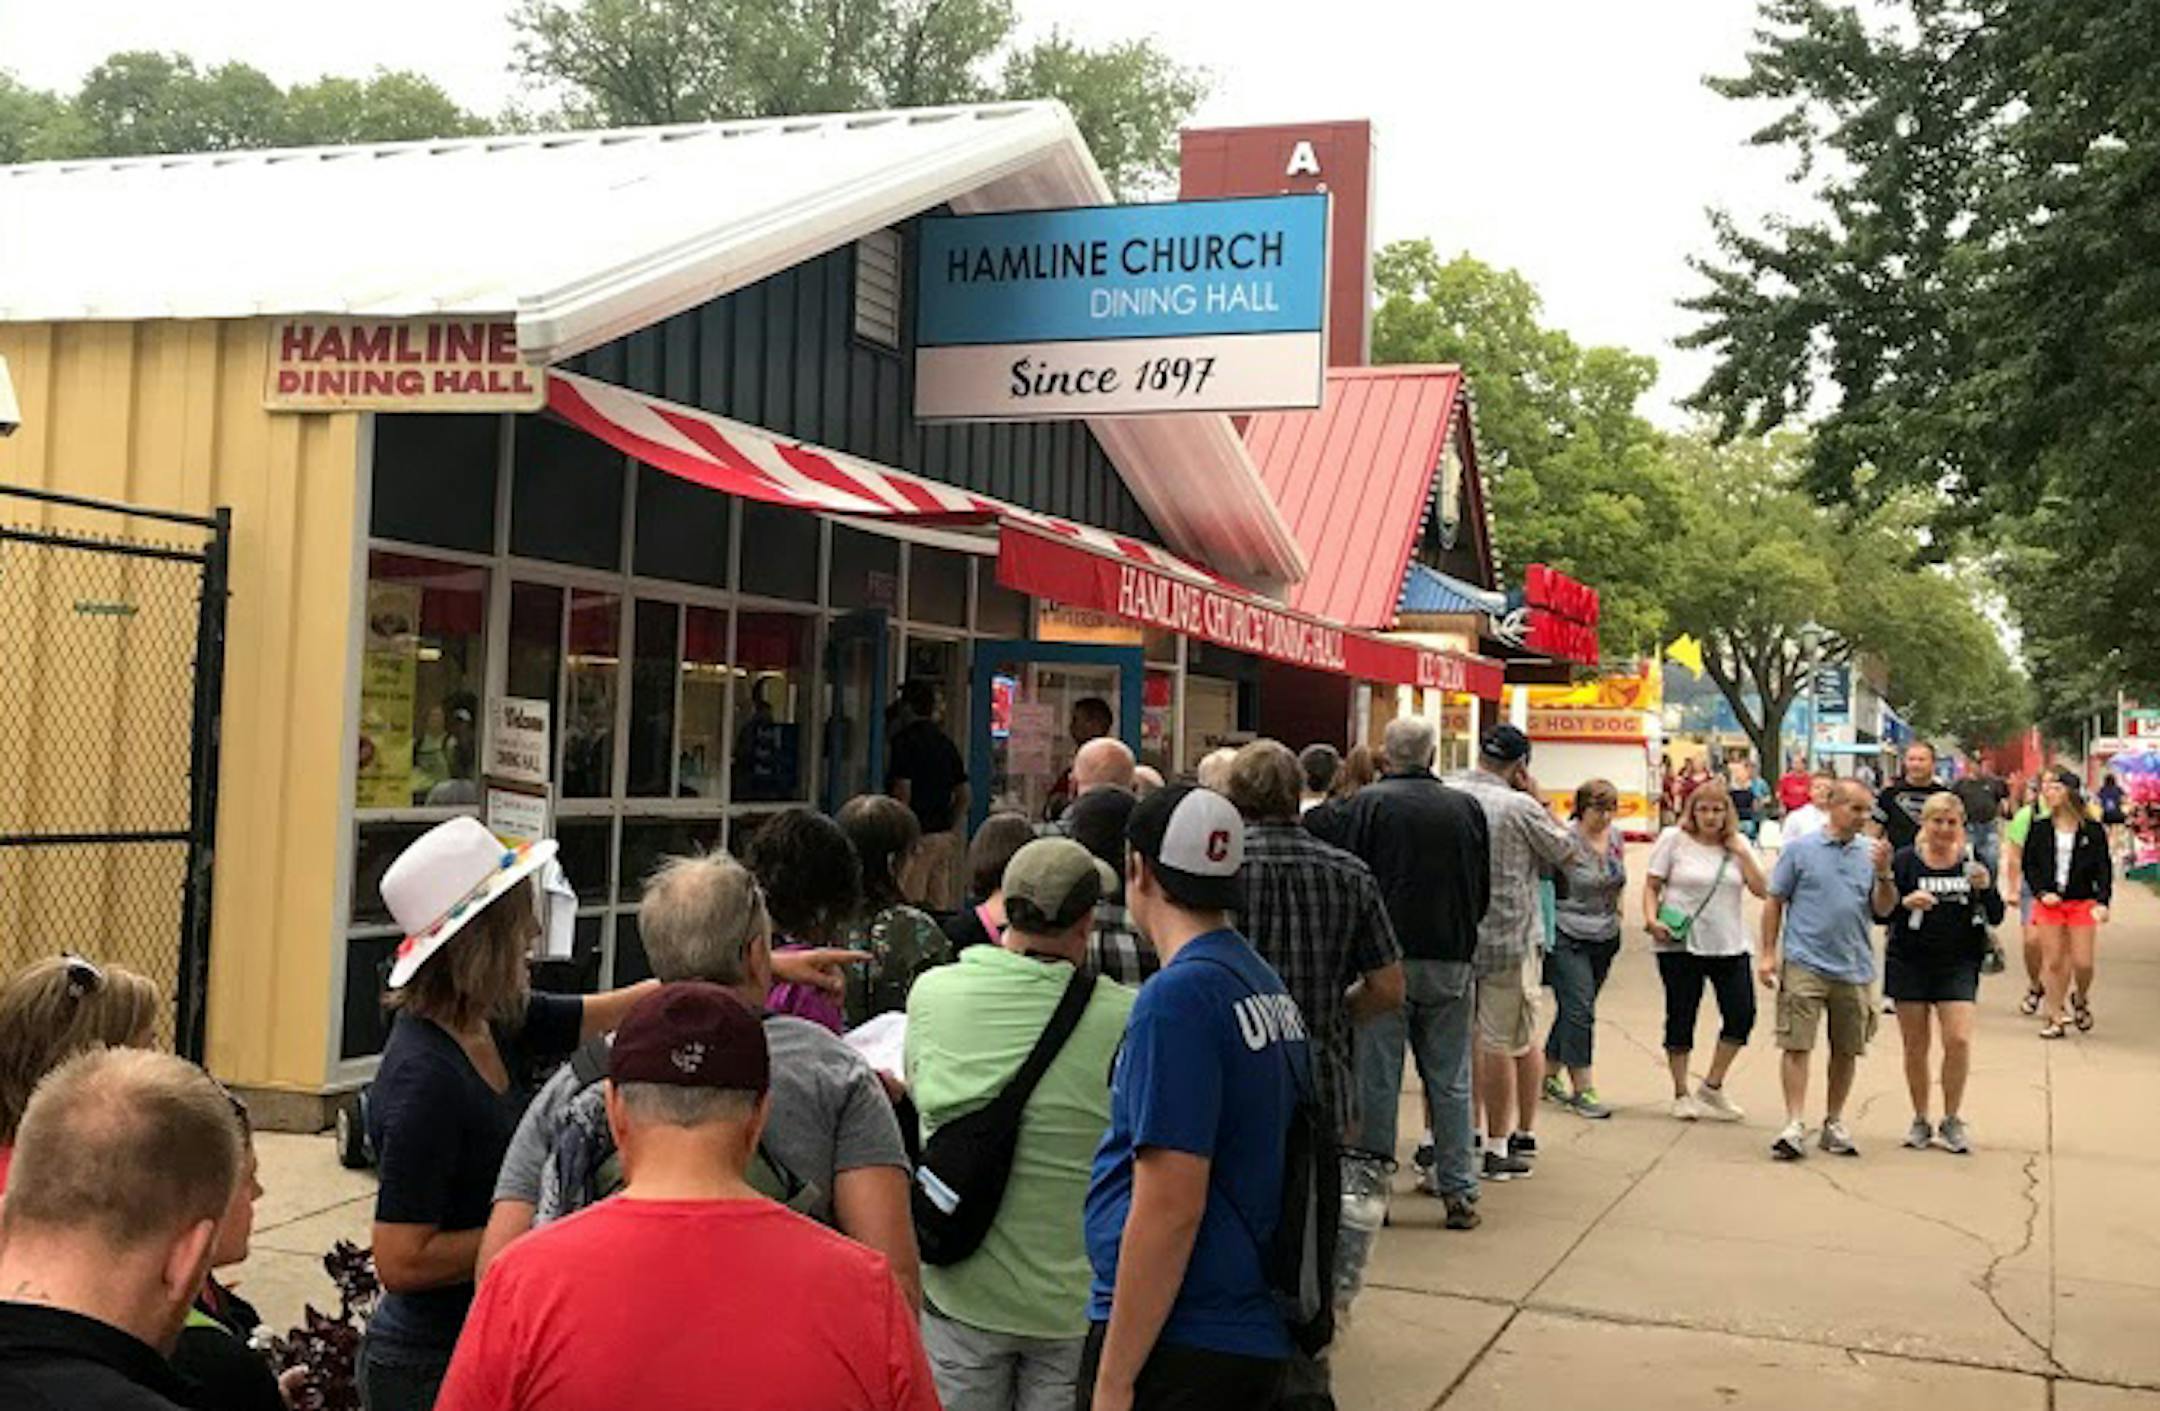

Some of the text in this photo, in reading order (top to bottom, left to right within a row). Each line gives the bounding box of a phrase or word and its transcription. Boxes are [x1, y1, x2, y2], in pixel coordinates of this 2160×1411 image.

[1286, 140, 1322, 176] A
[948, 230, 1284, 283] HAMLINE CHURCH
[1090, 281, 1279, 319] DINING HALL
[280, 323, 518, 364] HAMLINE
[277, 370, 534, 395] DINING HALL
[1010, 354, 1217, 399] Since 1897
[1118, 565, 1202, 636] HAMLINE
[1203, 590, 1265, 652] CHURCH
[1265, 609, 1312, 664] DINING
[1312, 625, 1346, 670] HALL
[1547, 715, 1586, 731] HOT
[1592, 715, 1637, 732] DOG
[1205, 830, 1231, 862] C
